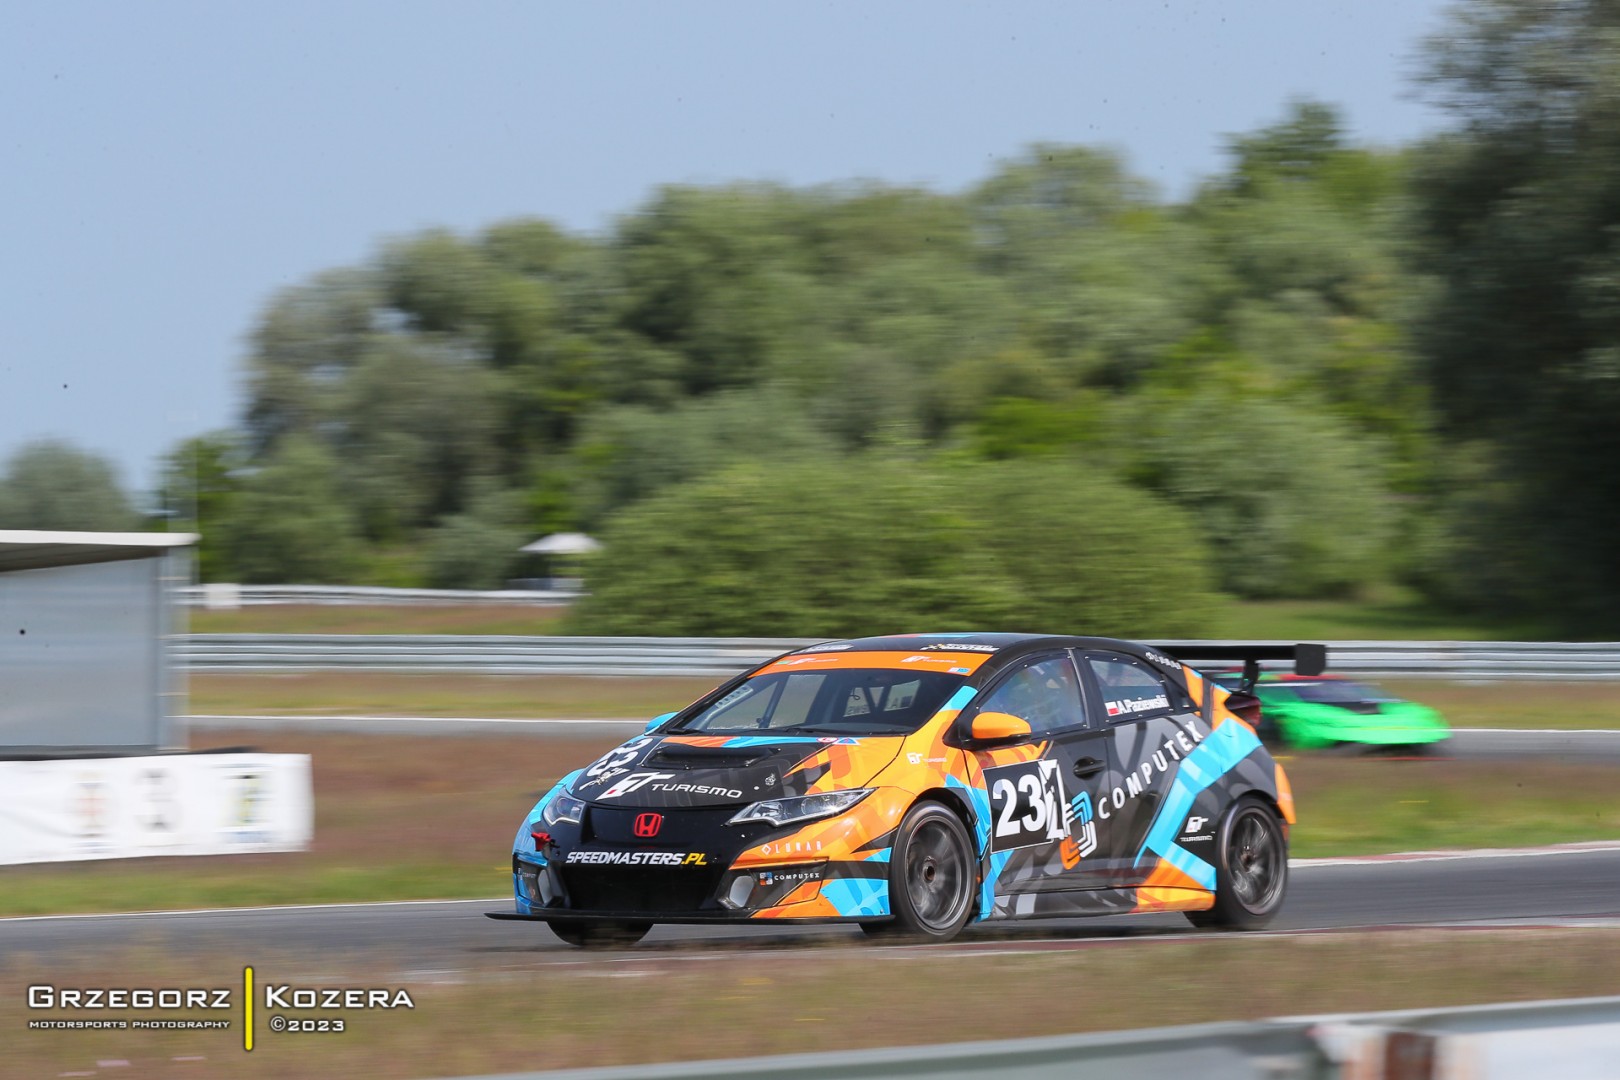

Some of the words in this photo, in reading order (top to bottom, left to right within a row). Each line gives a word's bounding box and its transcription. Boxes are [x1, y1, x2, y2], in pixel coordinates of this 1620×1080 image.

[1098, 720, 1204, 819] COMPUTEX
[651, 783, 743, 798] TURISMO
[565, 851, 708, 866] SPEEDMASTERS.PL
[774, 872, 820, 880] COMPUTEX
